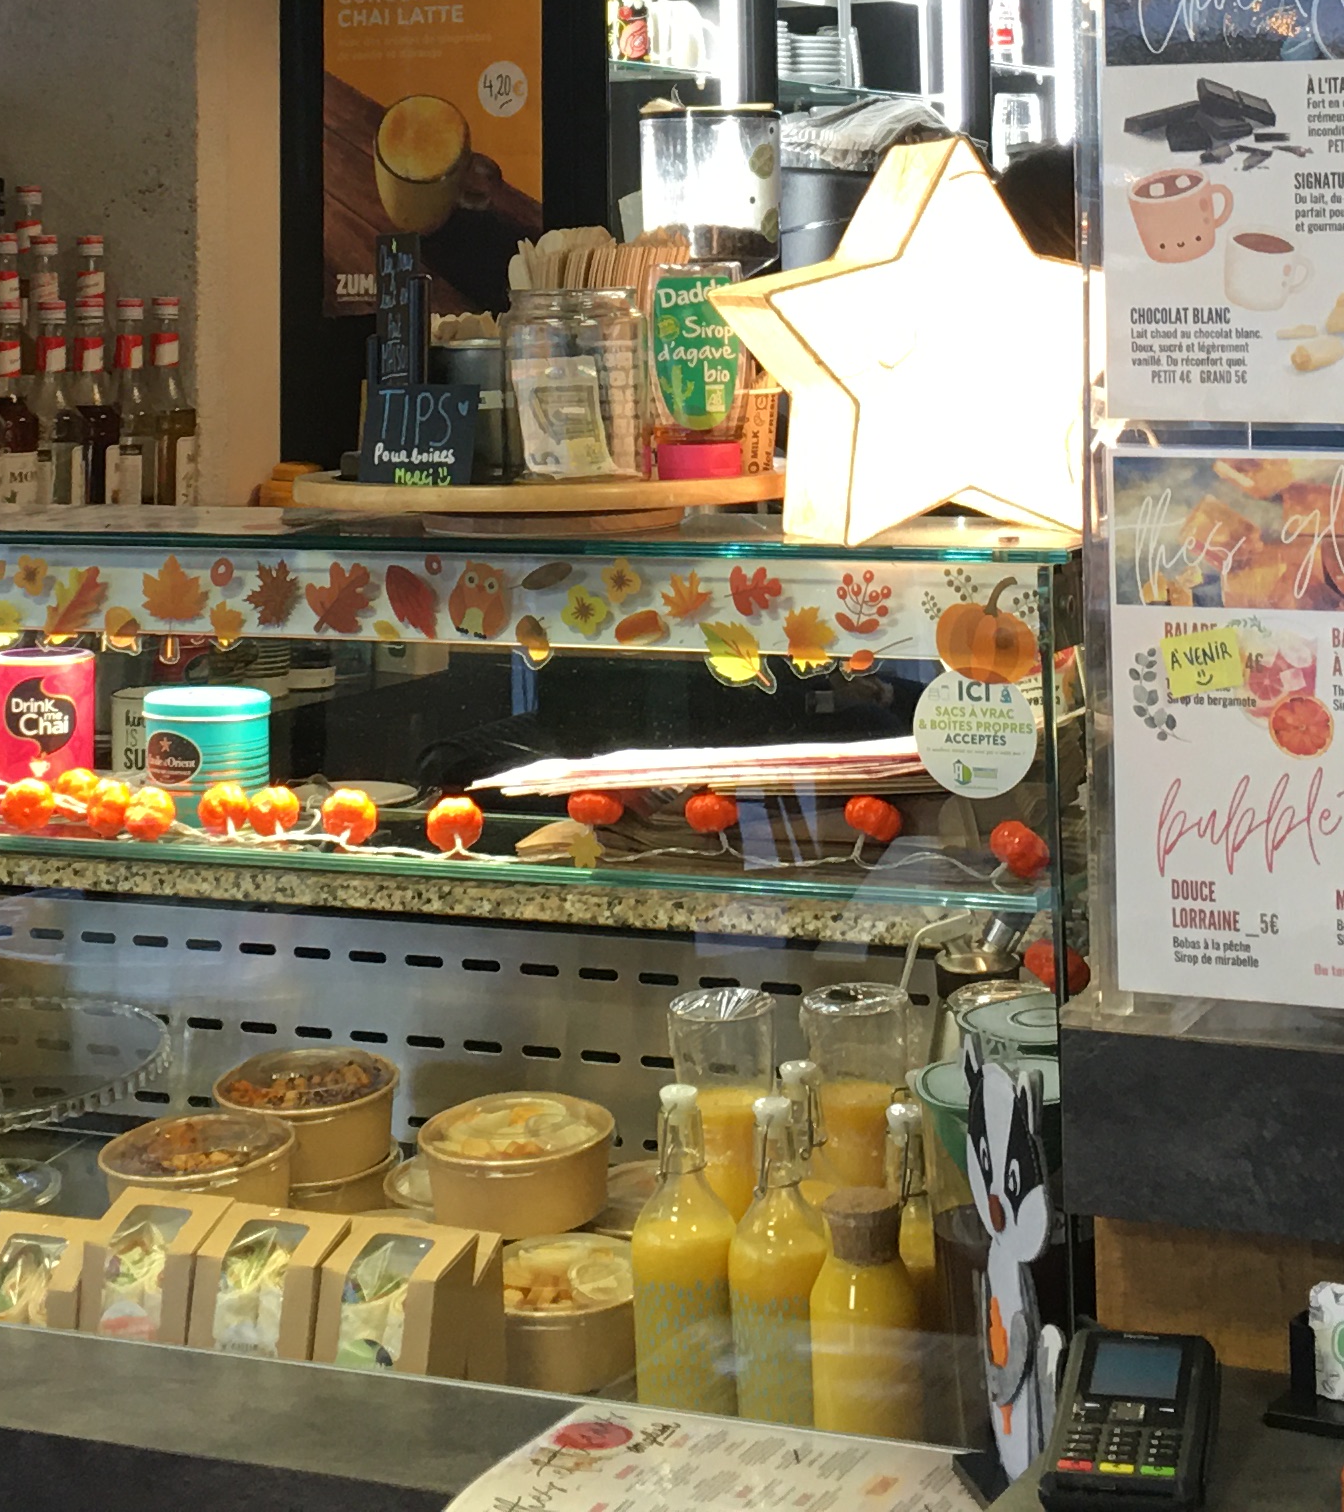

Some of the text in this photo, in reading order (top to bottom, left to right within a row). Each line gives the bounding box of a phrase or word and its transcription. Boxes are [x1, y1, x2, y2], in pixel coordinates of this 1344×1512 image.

[337, 5, 464, 27] CHAI LATTE
[1307, 75, 1315, 94] À
[1306, 97, 1325, 109] Fort
[1328, 98, 1340, 108] en
[337, 274, 376, 295] ZUM
[1130, 307, 1231, 325] CHOCOLAT BLANC
[682, 316, 734, 344] Sirop
[658, 340, 736, 367] d'agave
[704, 361, 730, 382] bio
[379, 389, 451, 446] TIPS
[751, 430, 759, 458] MILK
[1333, 653, 1343, 677] À
[958, 681, 990, 702] ICI
[11, 697, 55, 712] Drink
[936, 705, 1014, 719] SACS À VRAC
[20, 713, 69, 735] Chai
[919, 717, 1033, 734] & BOÎTES PROPRES
[945, 732, 1006, 746] ACCEPTÉS
[1171, 879, 1216, 903] DOUCE
[1172, 908, 1240, 932] LORRAINE
